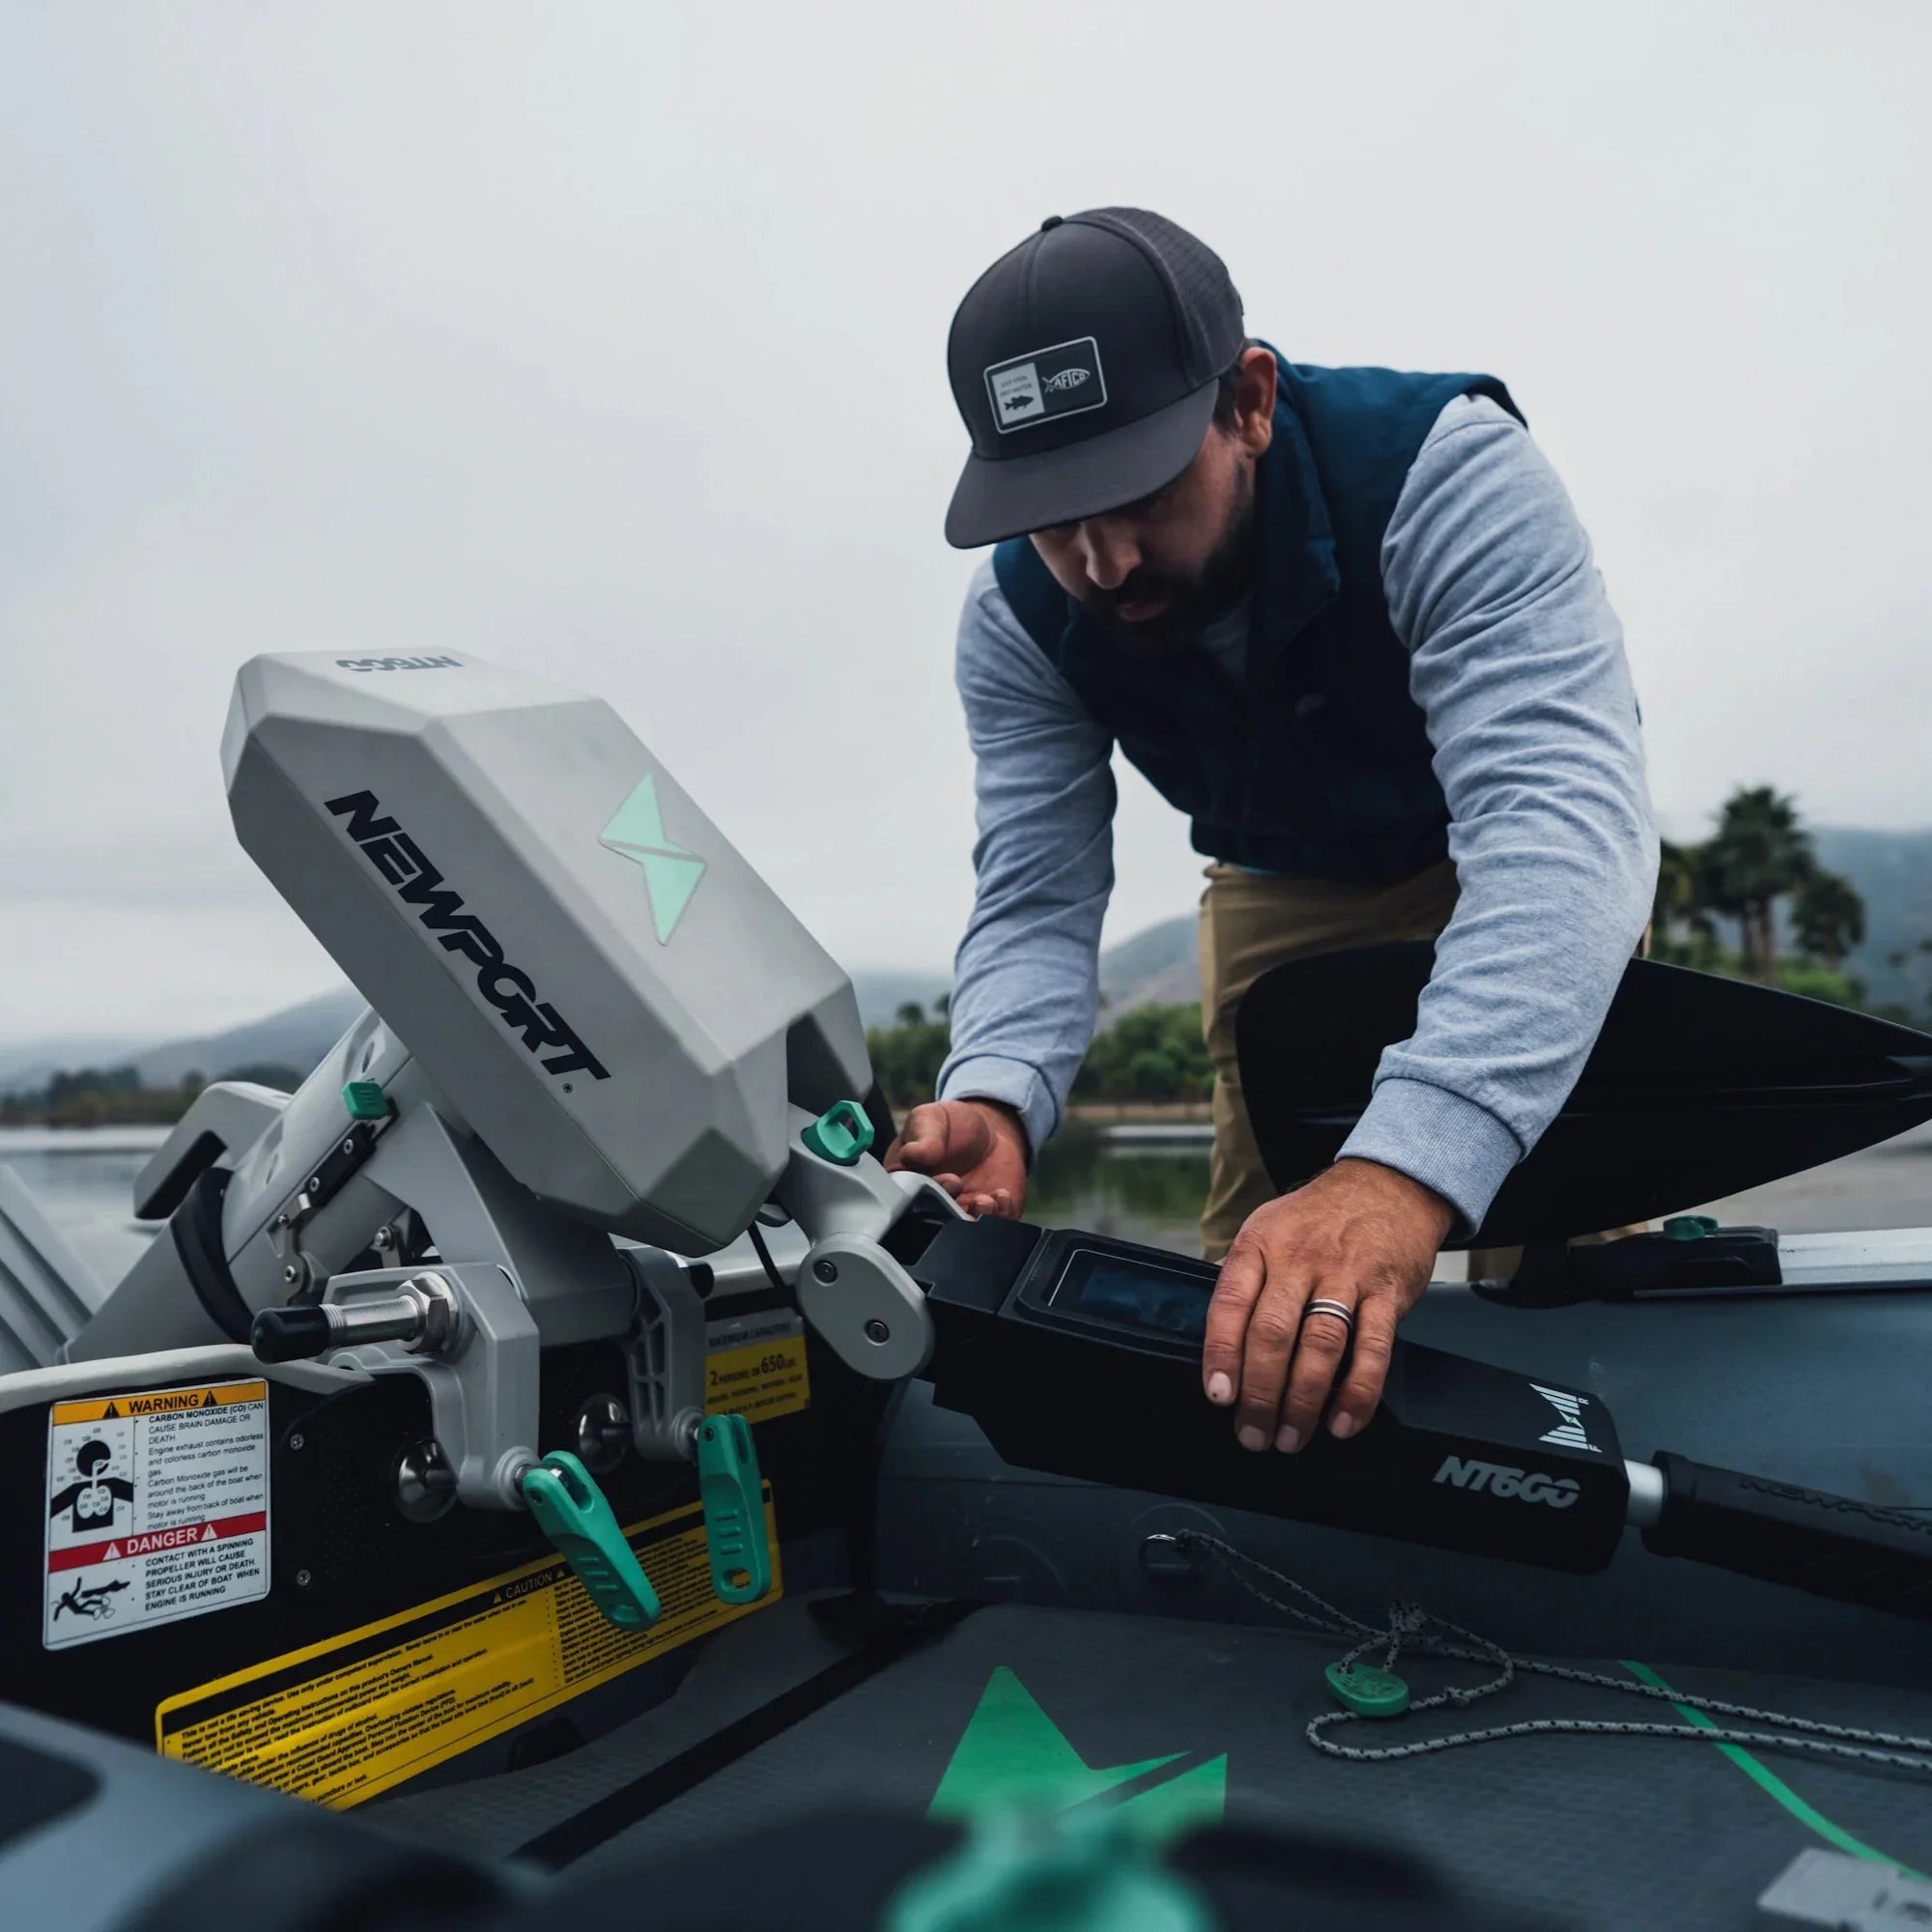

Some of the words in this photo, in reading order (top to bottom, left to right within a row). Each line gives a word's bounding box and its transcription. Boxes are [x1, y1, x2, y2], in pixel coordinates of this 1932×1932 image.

[1049, 370, 1088, 390] AFTCO
[324, 789, 611, 1080] NEWPORT
[710, 1370, 718, 1386] 2
[129, 1394, 199, 1414] WARNING
[149, 1411, 184, 1424] CARBON
[185, 1406, 228, 1419] MONOXIDE
[247, 1403, 263, 1411] CAN
[1577, 1397, 1590, 1406] R
[149, 1423, 176, 1435] CAUSE
[178, 1420, 203, 1431] BRAIN
[205, 1416, 238, 1428] DAMAGE
[239, 1414, 250, 1423] OR
[148, 1445, 174, 1458] Engine
[175, 1441, 203, 1452] exhaust
[205, 1437, 234, 1448] contains
[236, 1433, 264, 1443] odorless
[149, 1435, 176, 1444] DEATH
[148, 1457, 162, 1466] and
[197, 1449, 221, 1460] carbon
[223, 1444, 256, 1456] monoxide
[147, 1487, 174, 1498] around
[174, 1485, 186, 1494] the
[188, 1482, 205, 1492] back
[215, 1479, 226, 1488] the
[228, 1476, 243, 1486] boat
[244, 1473, 263, 1483] when
[148, 1476, 174, 1488] Carbon
[176, 1470, 211, 1484] Monoxide
[213, 1468, 226, 1480] gas
[227, 1467, 238, 1476] will
[240, 1465, 249, 1474] be
[1432, 1455, 1581, 1509] NT600
[147, 1497, 169, 1509] motor
[170, 1496, 178, 1505] is
[178, 1492, 206, 1506] running
[147, 1508, 164, 1522] Stay
[166, 1505, 185, 1519] away
[186, 1502, 202, 1513] from
[203, 1500, 219, 1510] back
[220, 1498, 228, 1507] of
[229, 1496, 244, 1506] boat
[245, 1493, 263, 1503] when
[127, 1527, 197, 1555] DANGER
[145, 1551, 185, 1567] CONTACT
[186, 1547, 208, 1559] WITH
[209, 1546, 214, 1554] A
[216, 1538, 254, 1553] SPINNING
[145, 1559, 195, 1577] PROPELLER
[197, 1555, 216, 1567] WILL
[218, 1549, 245, 1563] CAUSE
[145, 1574, 183, 1589] SERIOUS
[185, 1567, 213, 1581] INJURY
[214, 1564, 227, 1575] OR
[145, 1586, 166, 1601] STAY
[168, 1580, 195, 1596] CLEAR
[197, 1578, 209, 1589] OF
[211, 1574, 234, 1586] BOAT
[236, 1568, 260, 1580] WHEN
[505, 1572, 553, 1599] CAUTION
[145, 1596, 178, 1611] ENGINE
[179, 1594, 186, 1604] IS
[188, 1585, 226, 1602] RUNNING
